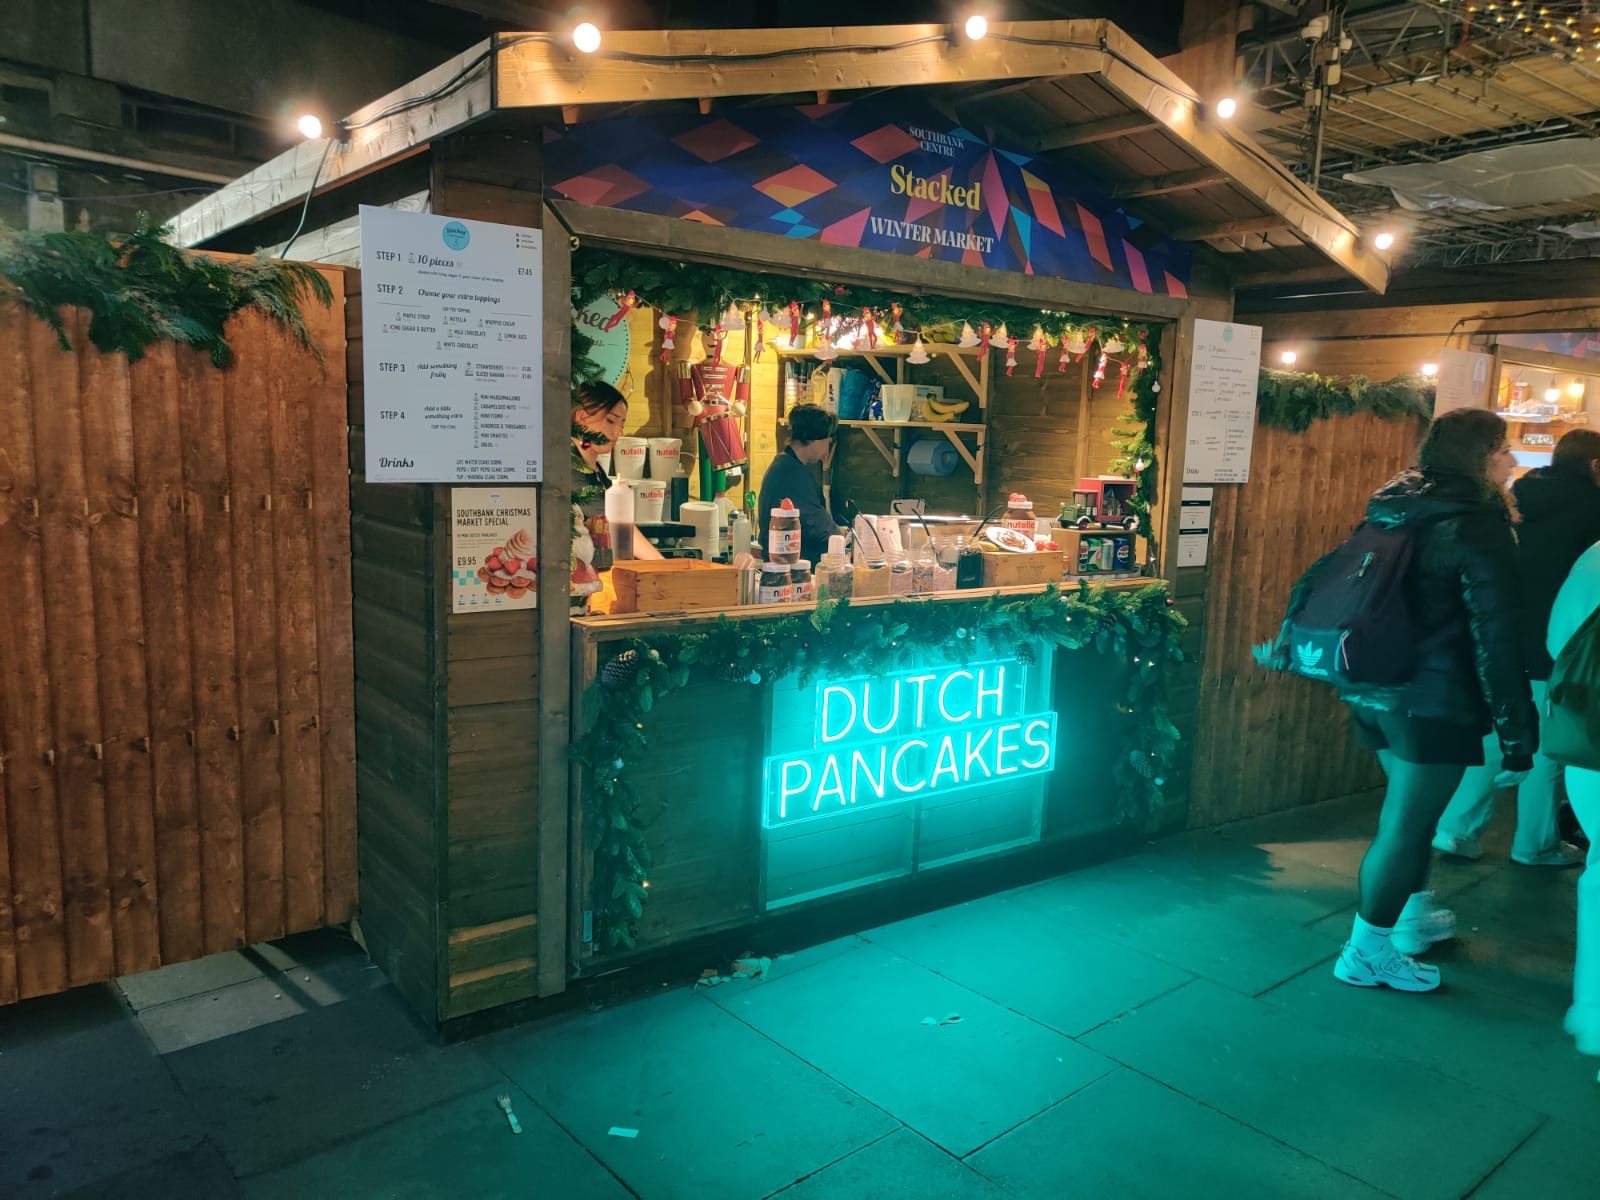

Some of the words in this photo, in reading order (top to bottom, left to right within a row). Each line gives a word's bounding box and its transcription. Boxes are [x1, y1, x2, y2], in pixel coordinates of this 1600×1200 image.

[909, 126, 965, 149] SOUTHBANK
[920, 140, 955, 157] CENTRE
[890, 164, 981, 211] Stacked
[871, 216, 931, 243] WINTER
[933, 228, 994, 253] MARKET
[376, 251, 395, 261] STEP
[397, 253, 401, 262] 1
[418, 254, 428, 264] 10
[429, 257, 454, 267] pieces
[377, 284, 396, 294] STEP
[398, 286, 403, 295] 2
[418, 288, 440, 298] Choose
[441, 291, 456, 300] your
[474, 294, 501, 304] toppings
[379, 362, 399, 372] STEP
[400, 363, 405, 372] 3
[380, 410, 398, 420] STEP
[400, 411, 405, 420] 4
[379, 457, 414, 468] Drinks
[456, 509, 494, 518] SOUTHBANK
[496, 508, 531, 517] CHRISTMAS
[457, 518, 482, 526] MARKET
[485, 518, 509, 526] SPECIAL
[820, 665, 1007, 743] DUTCH
[778, 719, 1051, 818] PANCAKES
